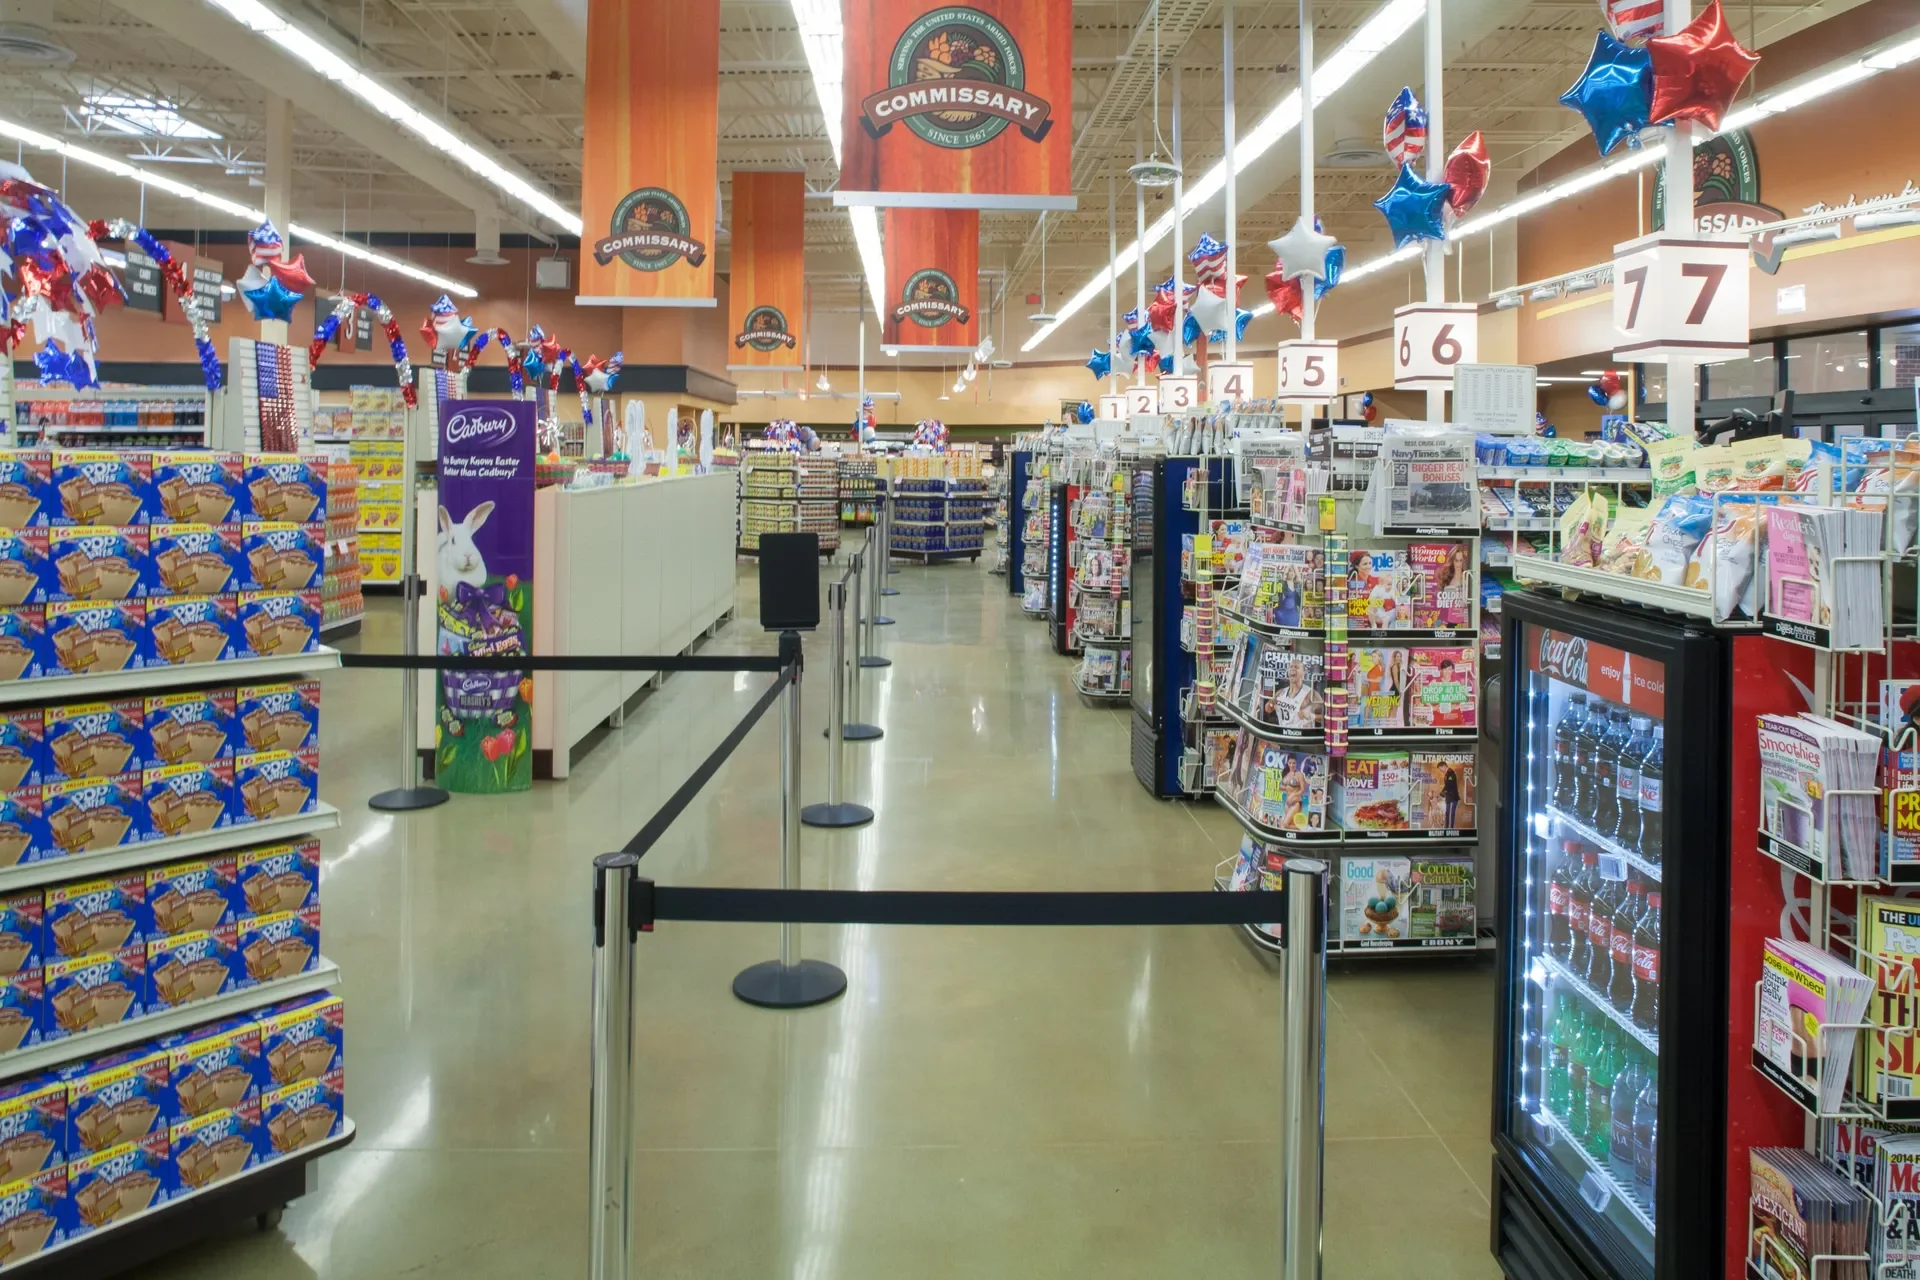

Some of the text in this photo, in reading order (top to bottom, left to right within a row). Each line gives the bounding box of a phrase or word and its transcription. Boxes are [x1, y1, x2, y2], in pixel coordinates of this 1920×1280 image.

[897, 12, 1017, 76] SERVING THE UNITED STATES ARMED FORCES
[874, 86, 1040, 121] COMMISSARY
[927, 129, 987, 145] SINCE 1867
[1737, 144, 1751, 184] FORCES
[602, 234, 698, 255] COMMISSARY
[1624, 265, 1649, 330] 7
[1681, 262, 1728, 325] 7
[896, 301, 965, 317] COMMISSARY
[739, 331, 793, 344] COMMISSARY
[1432, 324, 1463, 365] 6
[1400, 326, 1411, 367] 6
[1281, 356, 1288, 388] 5
[1303, 356, 1325, 387] 5
[1223, 374, 1244, 403] 4
[1174, 386, 1189, 407] 3
[1111, 402, 1118, 418] 1
[1137, 396, 1150, 413] 2
[447, 415, 507, 444] Cadbury
[57, 454, 73, 463] 16
[249, 456, 262, 464] 16
[470, 456, 494, 466] Knows
[495, 456, 520, 466] Easter
[1391, 449, 1440, 460] NavyTimes
[461, 467, 477, 477] than
[1411, 463, 1444, 473] BIGGER
[1422, 472, 1461, 482] BONUSES
[140, 510, 149, 518] 16
[1771, 511, 1816, 537] Reader's
[1662, 534, 1683, 548] Chips
[1410, 546, 1447, 555] Woman's
[1411, 556, 1437, 564] World
[495, 634, 520, 653] Eggs
[1265, 651, 1324, 666] CHAMPS!
[1600, 664, 1665, 694] enjoy ice cold
[1423, 686, 1443, 694] DROP
[1423, 694, 1439, 702] THIS
[112, 702, 129, 710] SAVE
[49, 710, 66, 720] 16
[1280, 708, 1290, 721] 13
[1759, 732, 1821, 768] Smoothies
[133, 756, 141, 764] 16
[1264, 750, 1288, 769] OK!
[1412, 753, 1474, 764] MILITARYSPOUSE
[1775, 752, 1795, 765] Frozen
[1346, 760, 1377, 775] EAT
[1463, 767, 1473, 775] 50
[1382, 772, 1399, 780] 150+
[1346, 861, 1374, 879] Good
[1418, 862, 1467, 876] Country
[1423, 874, 1465, 885] Gardens
[1881, 910, 1906, 925] THE
[1763, 950, 1825, 997] Lose the Wheat
[1763, 965, 1788, 989] Shrink
[1763, 976, 1781, 993] Your
[1762, 986, 1783, 1004] Belly
[317, 1006, 333, 1016] SAVE
[265, 1011, 312, 1033] 16 VALUE PACK
[137, 1062, 155, 1074] SAVE
[74, 1071, 131, 1096] 16 VALUE PACK
[1863, 1119, 1906, 1134] FITNESS
[1890, 1154, 1914, 1164] 2014
[1750, 1190, 1806, 1242] MEXICAN!
[1885, 1268, 1916, 1280] DEATH!
